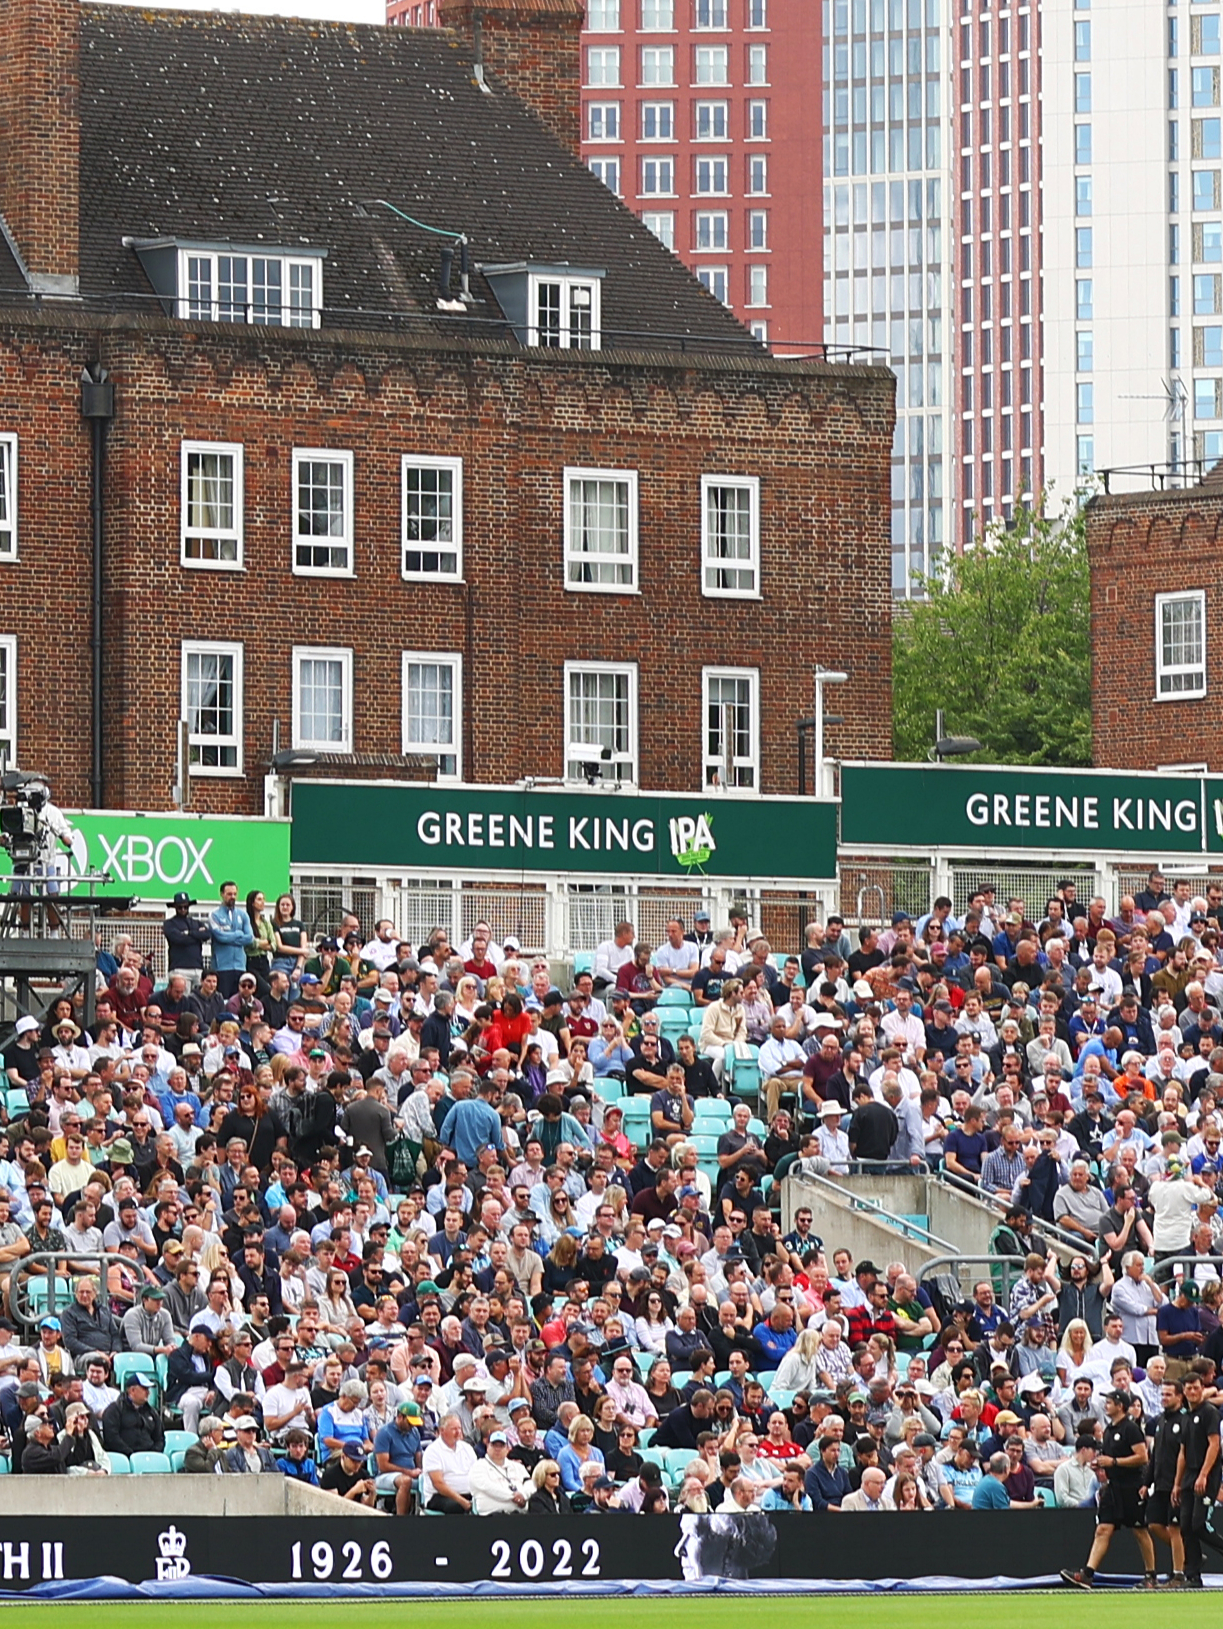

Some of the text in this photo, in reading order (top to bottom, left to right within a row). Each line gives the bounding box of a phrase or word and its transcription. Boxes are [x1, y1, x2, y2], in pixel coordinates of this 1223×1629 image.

[966, 793, 1099, 829] GREENE
[1114, 797, 1196, 832] KING
[417, 811, 717, 856] GREENE KING IPA
[97, 834, 214, 885] XBOX
[42, 1542, 64, 1580] II
[291, 1540, 393, 1579] 1926
[491, 1538, 601, 1577] 2022
